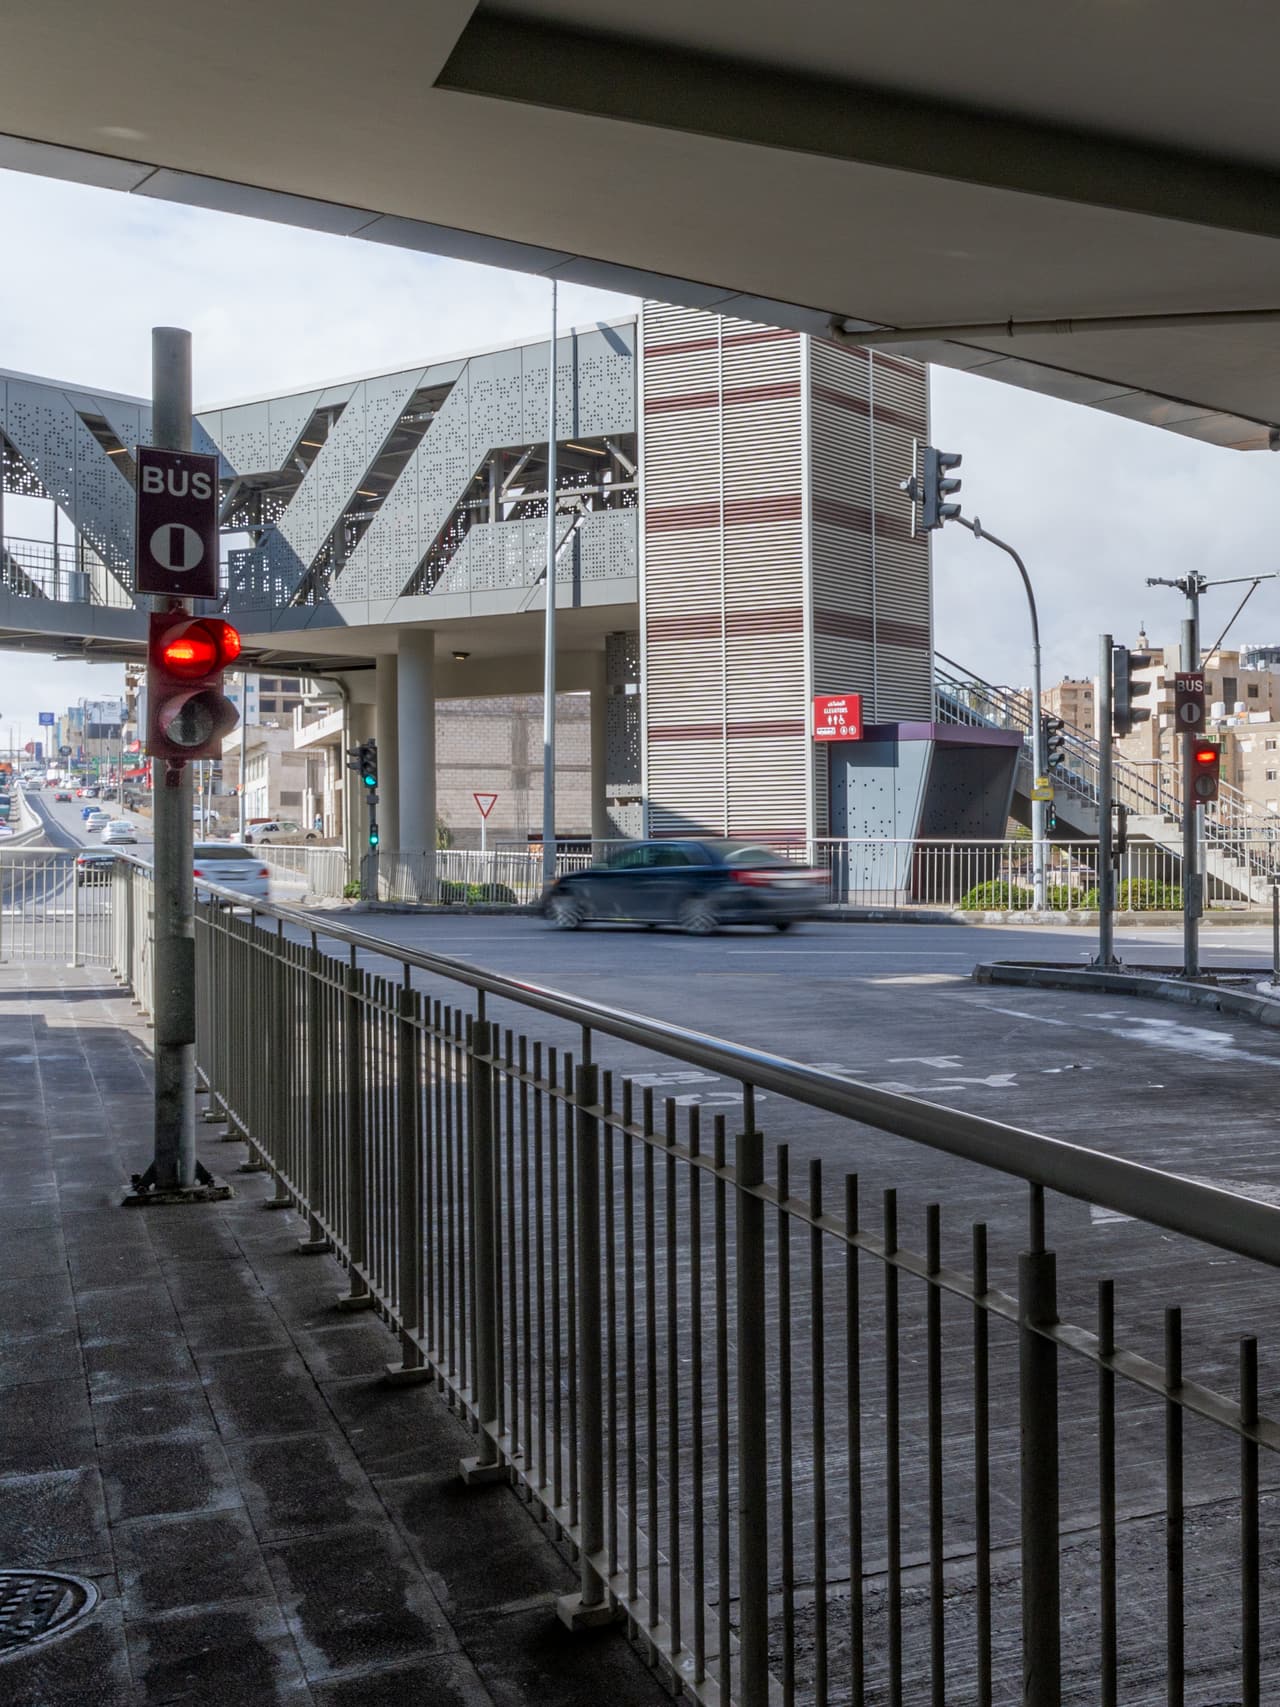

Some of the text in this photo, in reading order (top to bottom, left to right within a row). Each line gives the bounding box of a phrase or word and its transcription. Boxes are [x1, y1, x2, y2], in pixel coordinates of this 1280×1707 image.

[142, 465, 212, 500] BUS
[1177, 680, 1203, 692] BUS
[662, 1073, 1019, 1106] OLY
